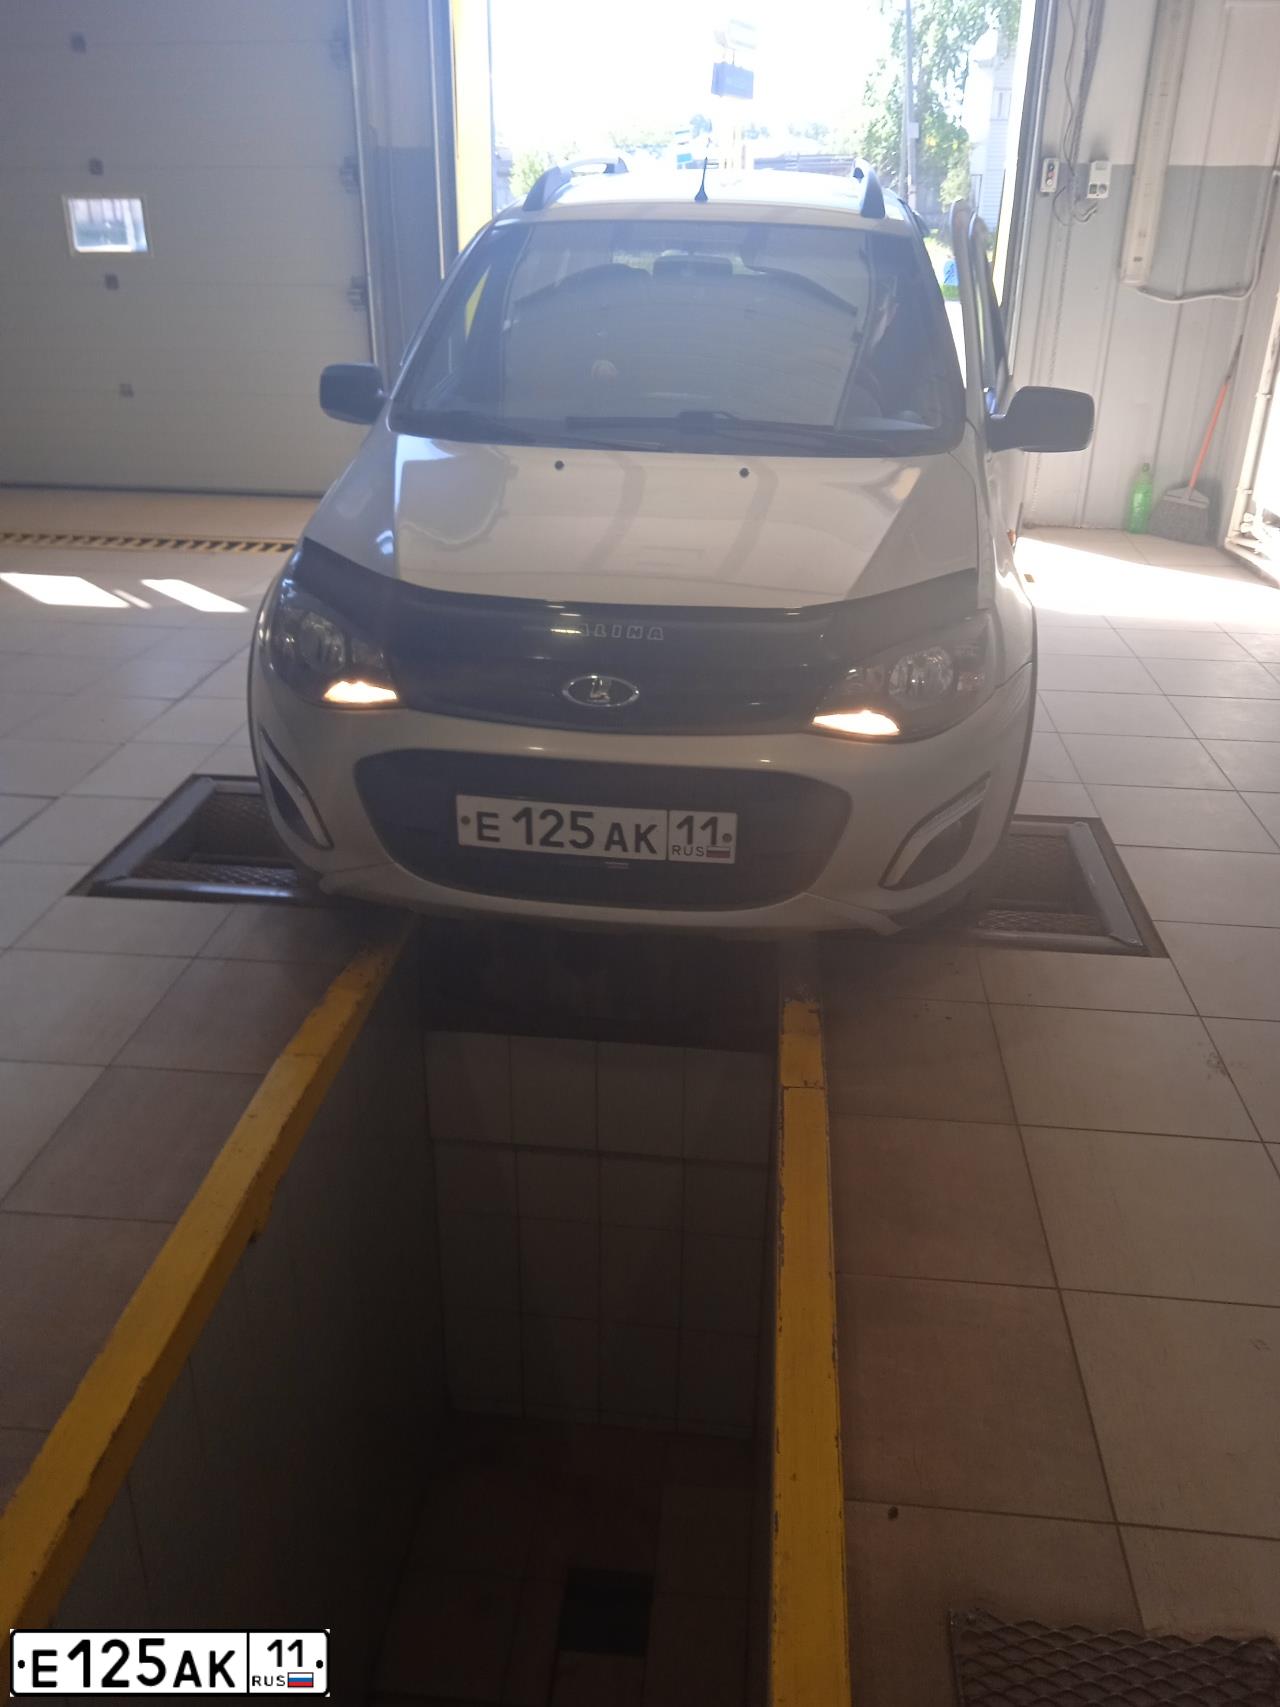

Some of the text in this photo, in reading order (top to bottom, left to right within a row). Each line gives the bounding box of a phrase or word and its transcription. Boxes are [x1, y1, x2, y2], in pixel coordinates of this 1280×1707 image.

[557, 623, 665, 641] LINA
[675, 814, 719, 846] 11
[671, 844, 705, 857] RUS
